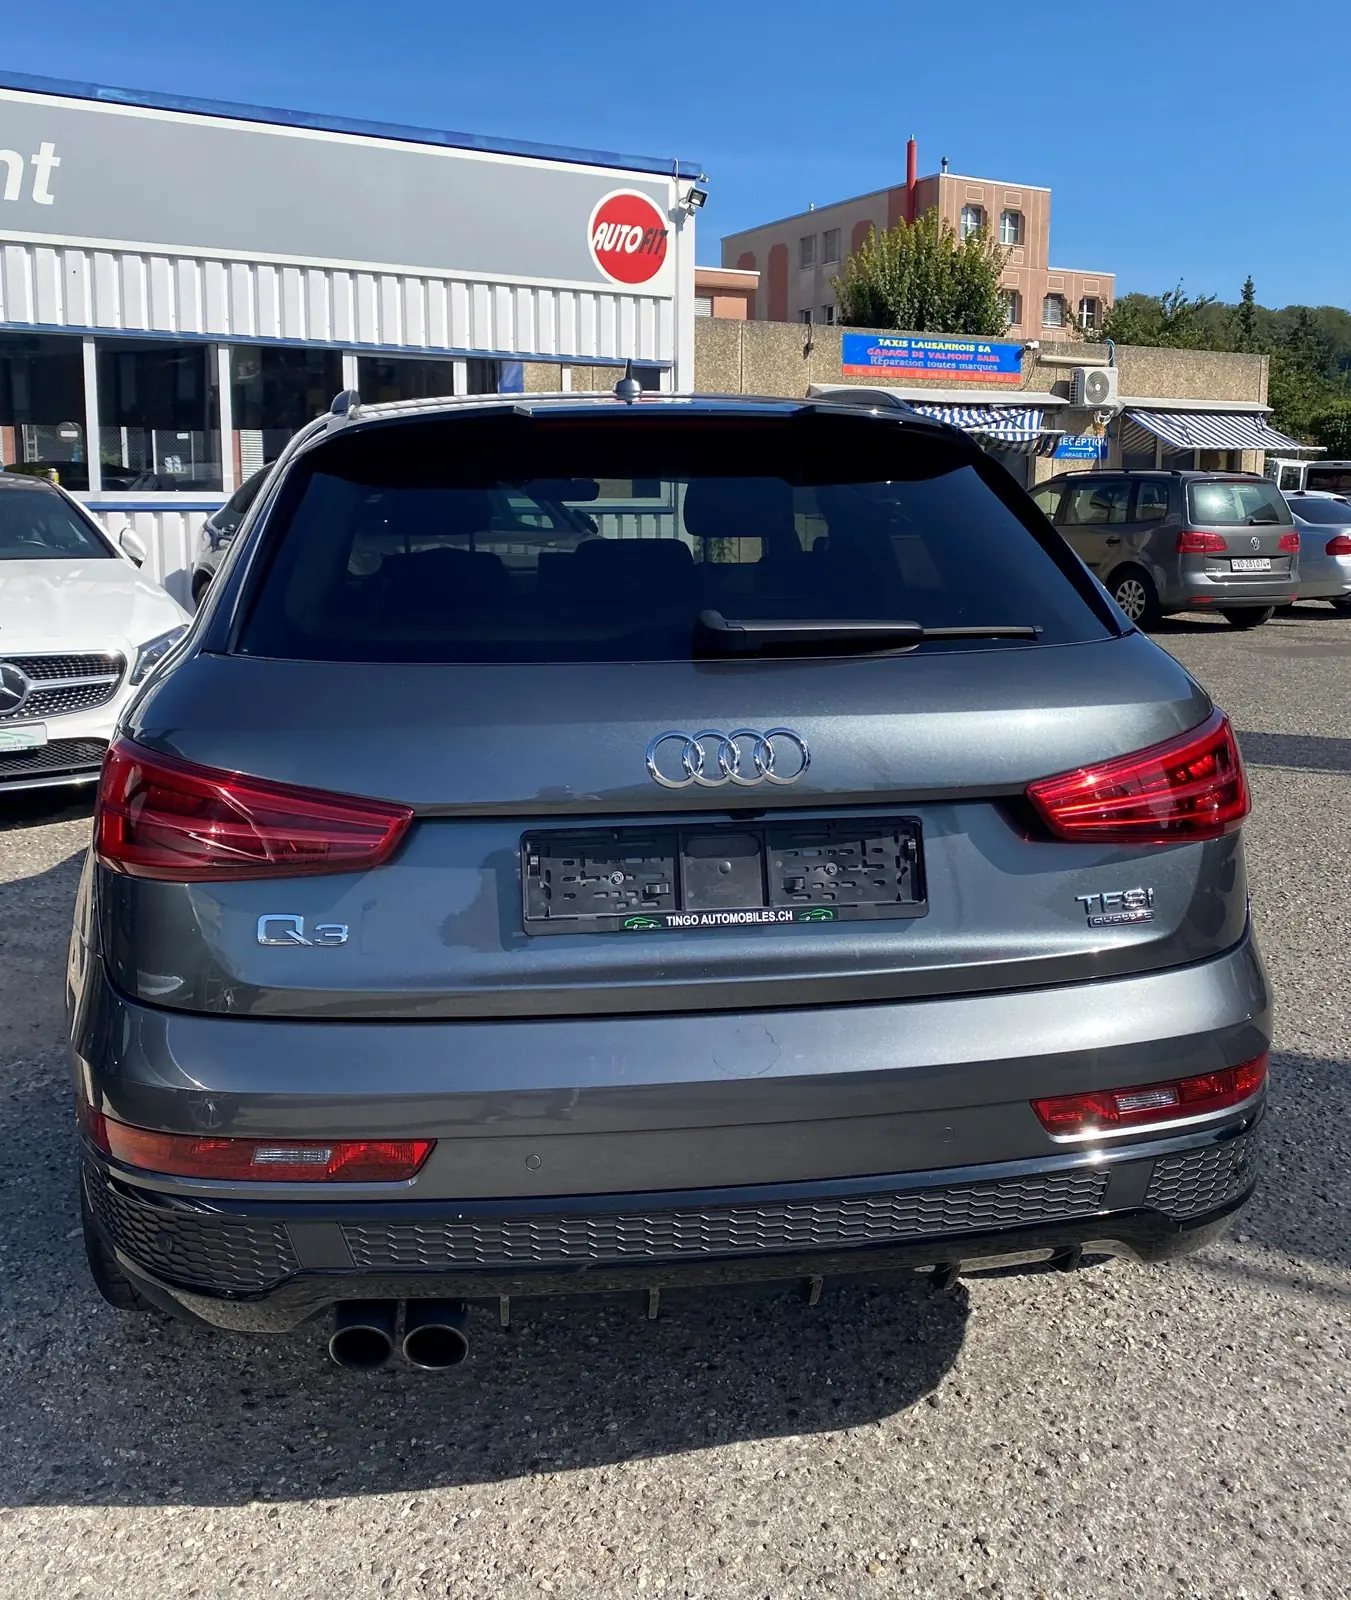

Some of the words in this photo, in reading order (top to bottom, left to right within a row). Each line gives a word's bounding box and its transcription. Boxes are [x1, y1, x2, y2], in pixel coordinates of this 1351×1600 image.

[867, 347, 908, 357] GARAGE
[912, 350, 924, 358] DE
[928, 351, 974, 361] VALMONT
[878, 338, 908, 347] TAXIS
[911, 340, 975, 352] LAUSANNOIS
[978, 345, 991, 353] SA
[870, 355, 924, 367] Réparation
[927, 360, 956, 369] toutes
[959, 362, 997, 372] marques
[666, 914, 699, 927] TINGO
[701, 910, 793, 925] AUTOMOBILES.CH
[257, 913, 349, 946] Q3
